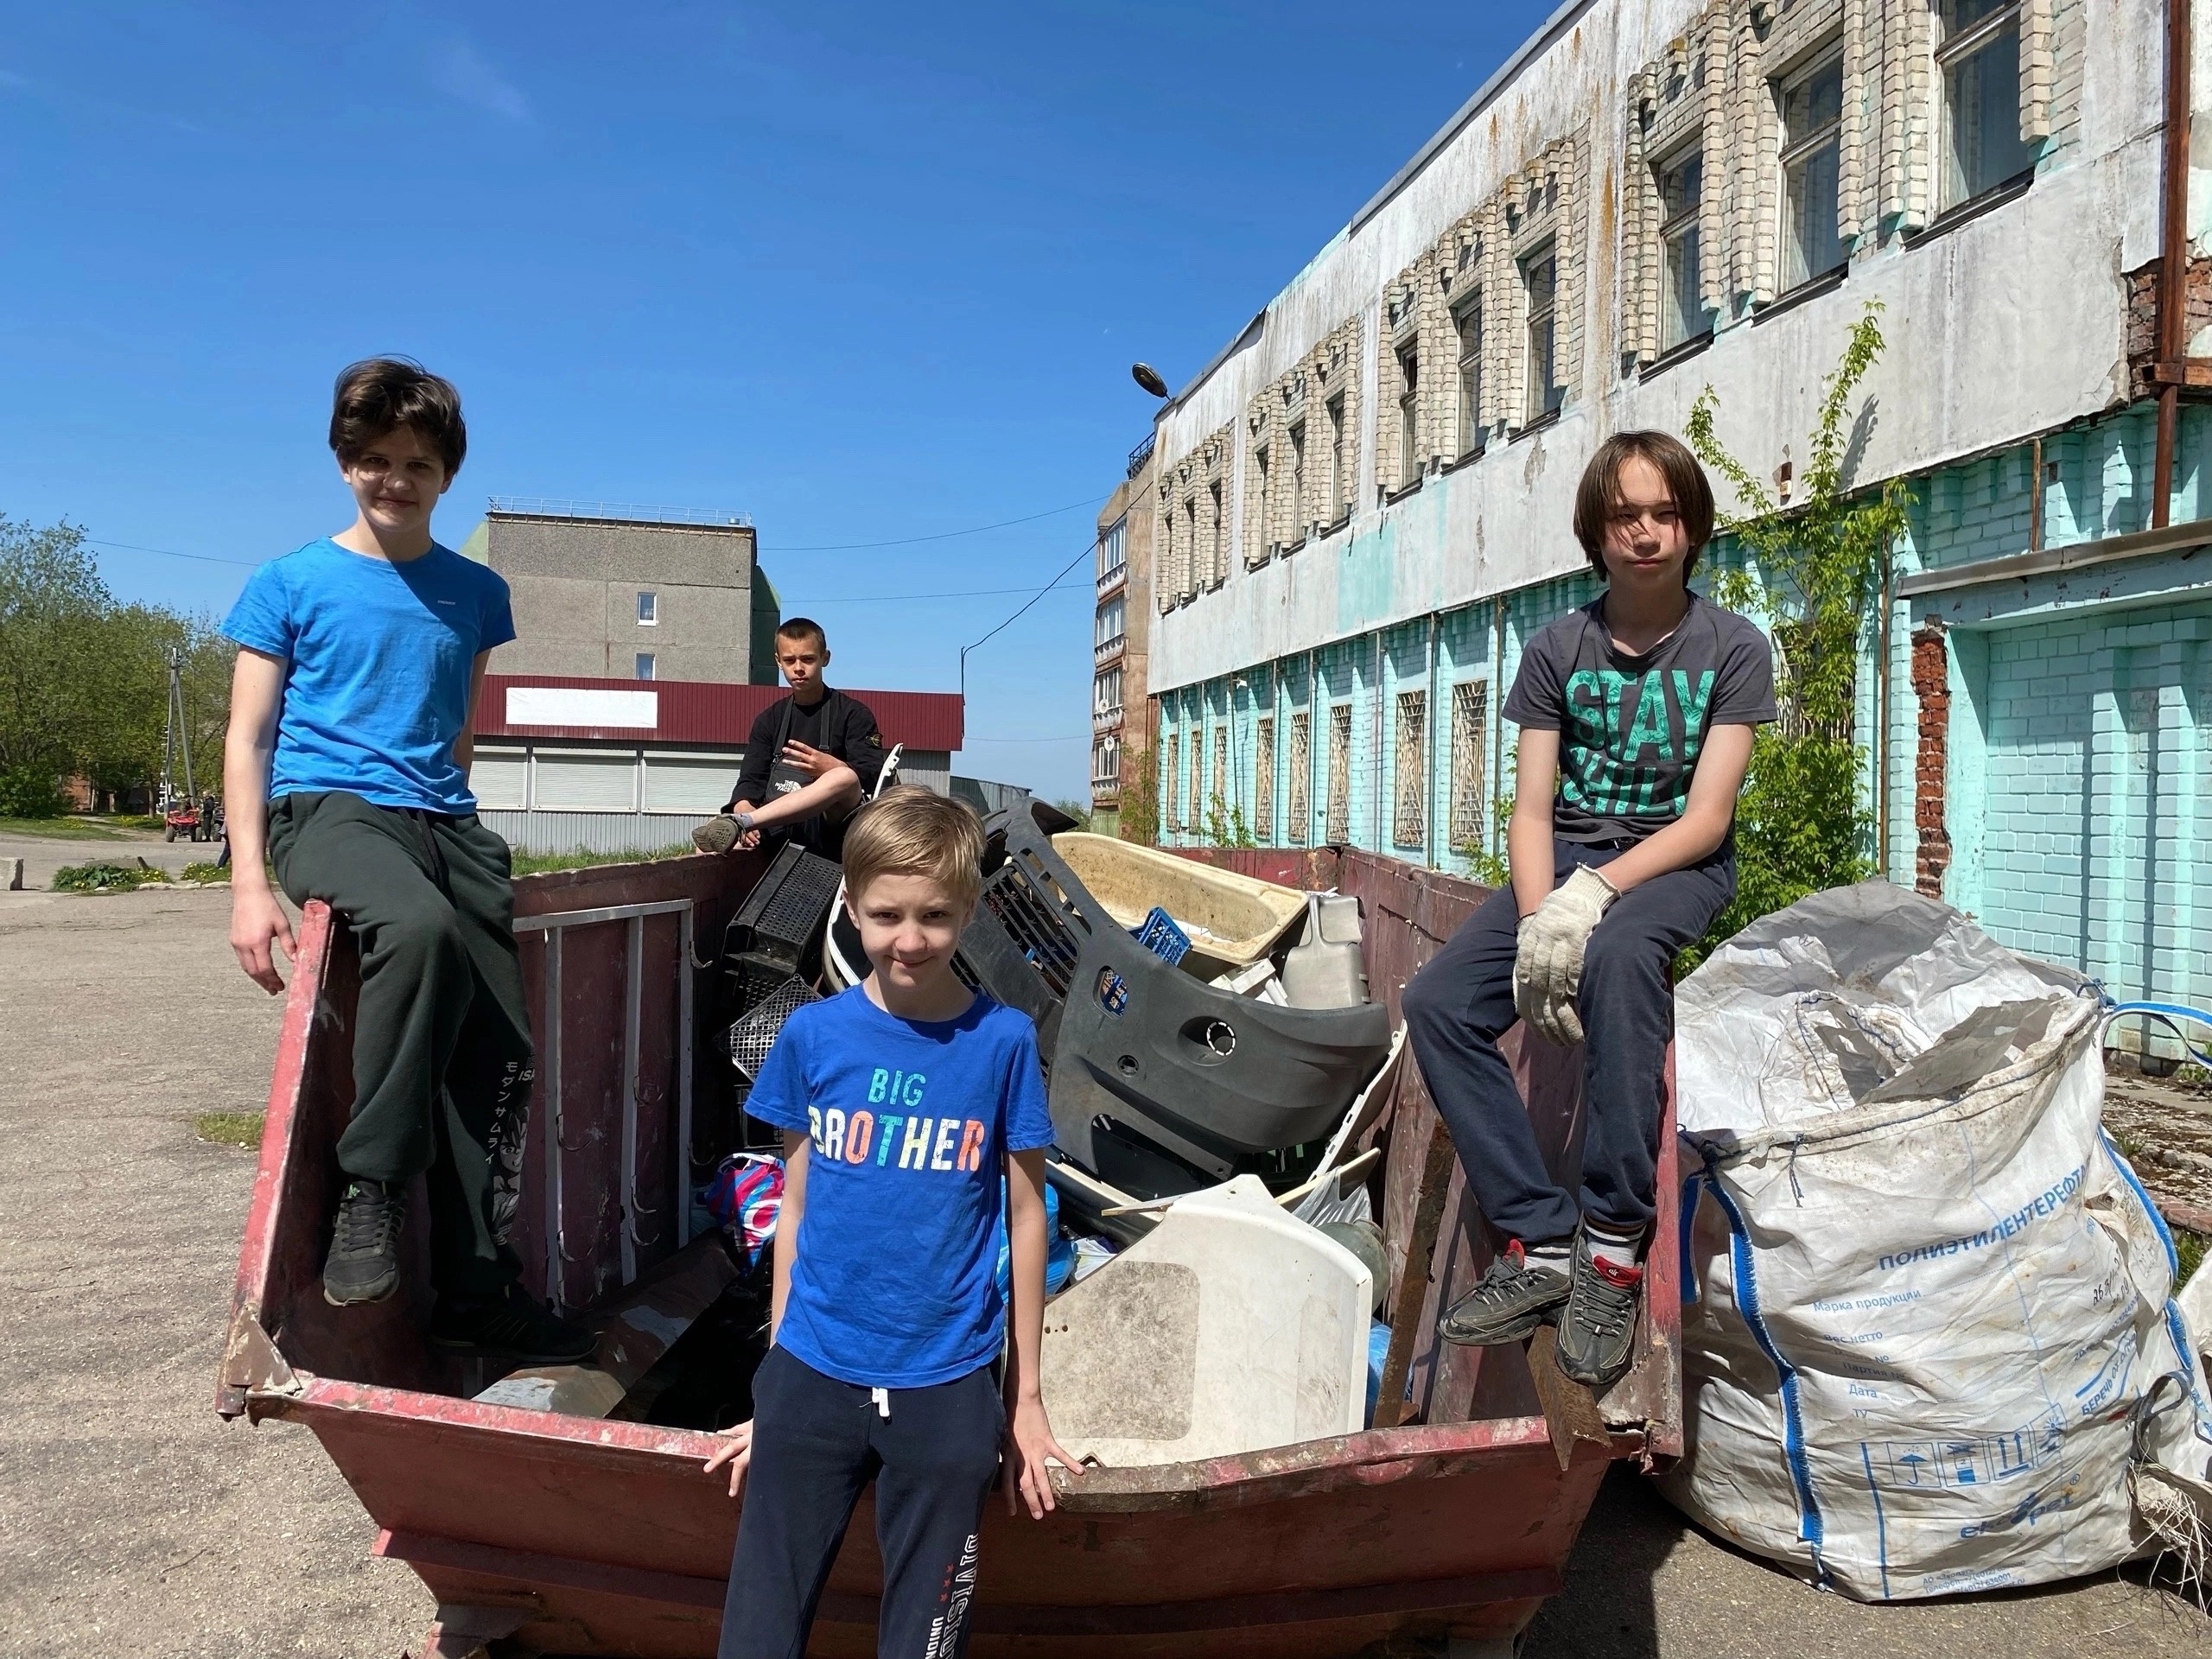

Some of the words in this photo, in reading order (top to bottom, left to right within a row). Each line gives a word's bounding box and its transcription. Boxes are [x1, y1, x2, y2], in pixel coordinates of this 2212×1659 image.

[1566, 670, 1715, 761] STAY
[868, 1068, 926, 1107] BIG
[485, 1061, 518, 1165] モダンサムライ
[1813, 1300, 1853, 1313] Марка
[1856, 1289, 1922, 1310] продукции
[1850, 1332, 1883, 1344] нетто
[1849, 1383, 1878, 1398] Дата
[2081, 1377, 2113, 1416] БЕРЕЧЬ
[1853, 1408, 1868, 1419] ТУ
